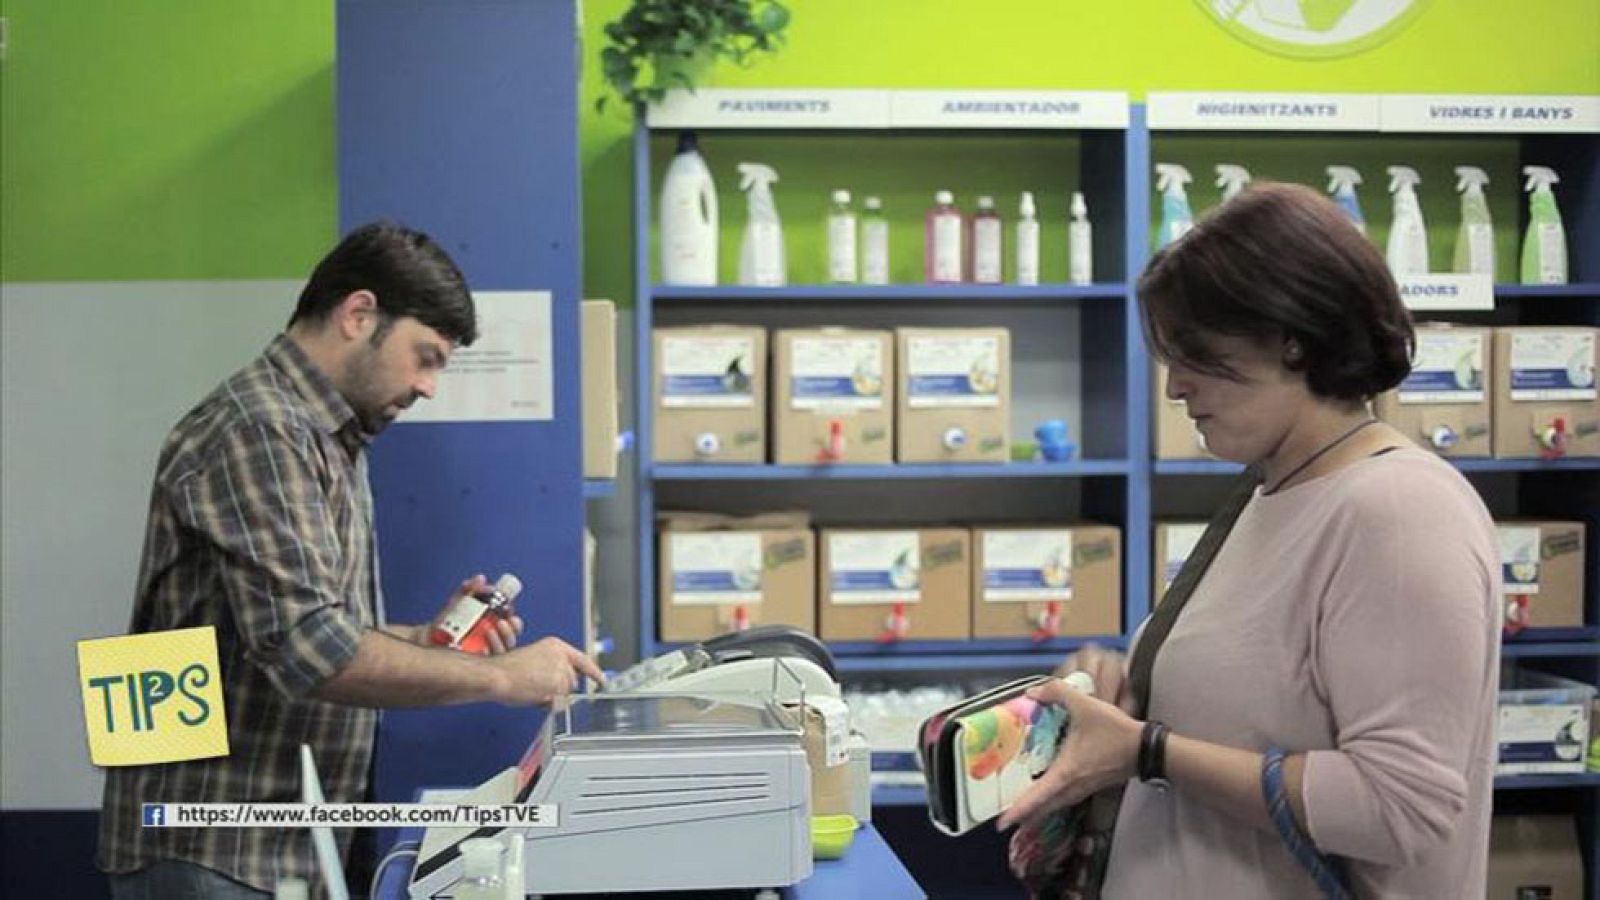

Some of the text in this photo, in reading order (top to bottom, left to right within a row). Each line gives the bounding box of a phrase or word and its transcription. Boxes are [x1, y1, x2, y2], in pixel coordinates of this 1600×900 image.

[717, 99, 831, 114] PAVIMENTS
[941, 100, 1082, 115] AMBIENTADOR
[1196, 101, 1339, 117] HIGIENITZANTS
[1429, 105, 1494, 119] VIDRES
[1511, 105, 1574, 120] BANYS
[1400, 283, 1459, 297] ADORS
